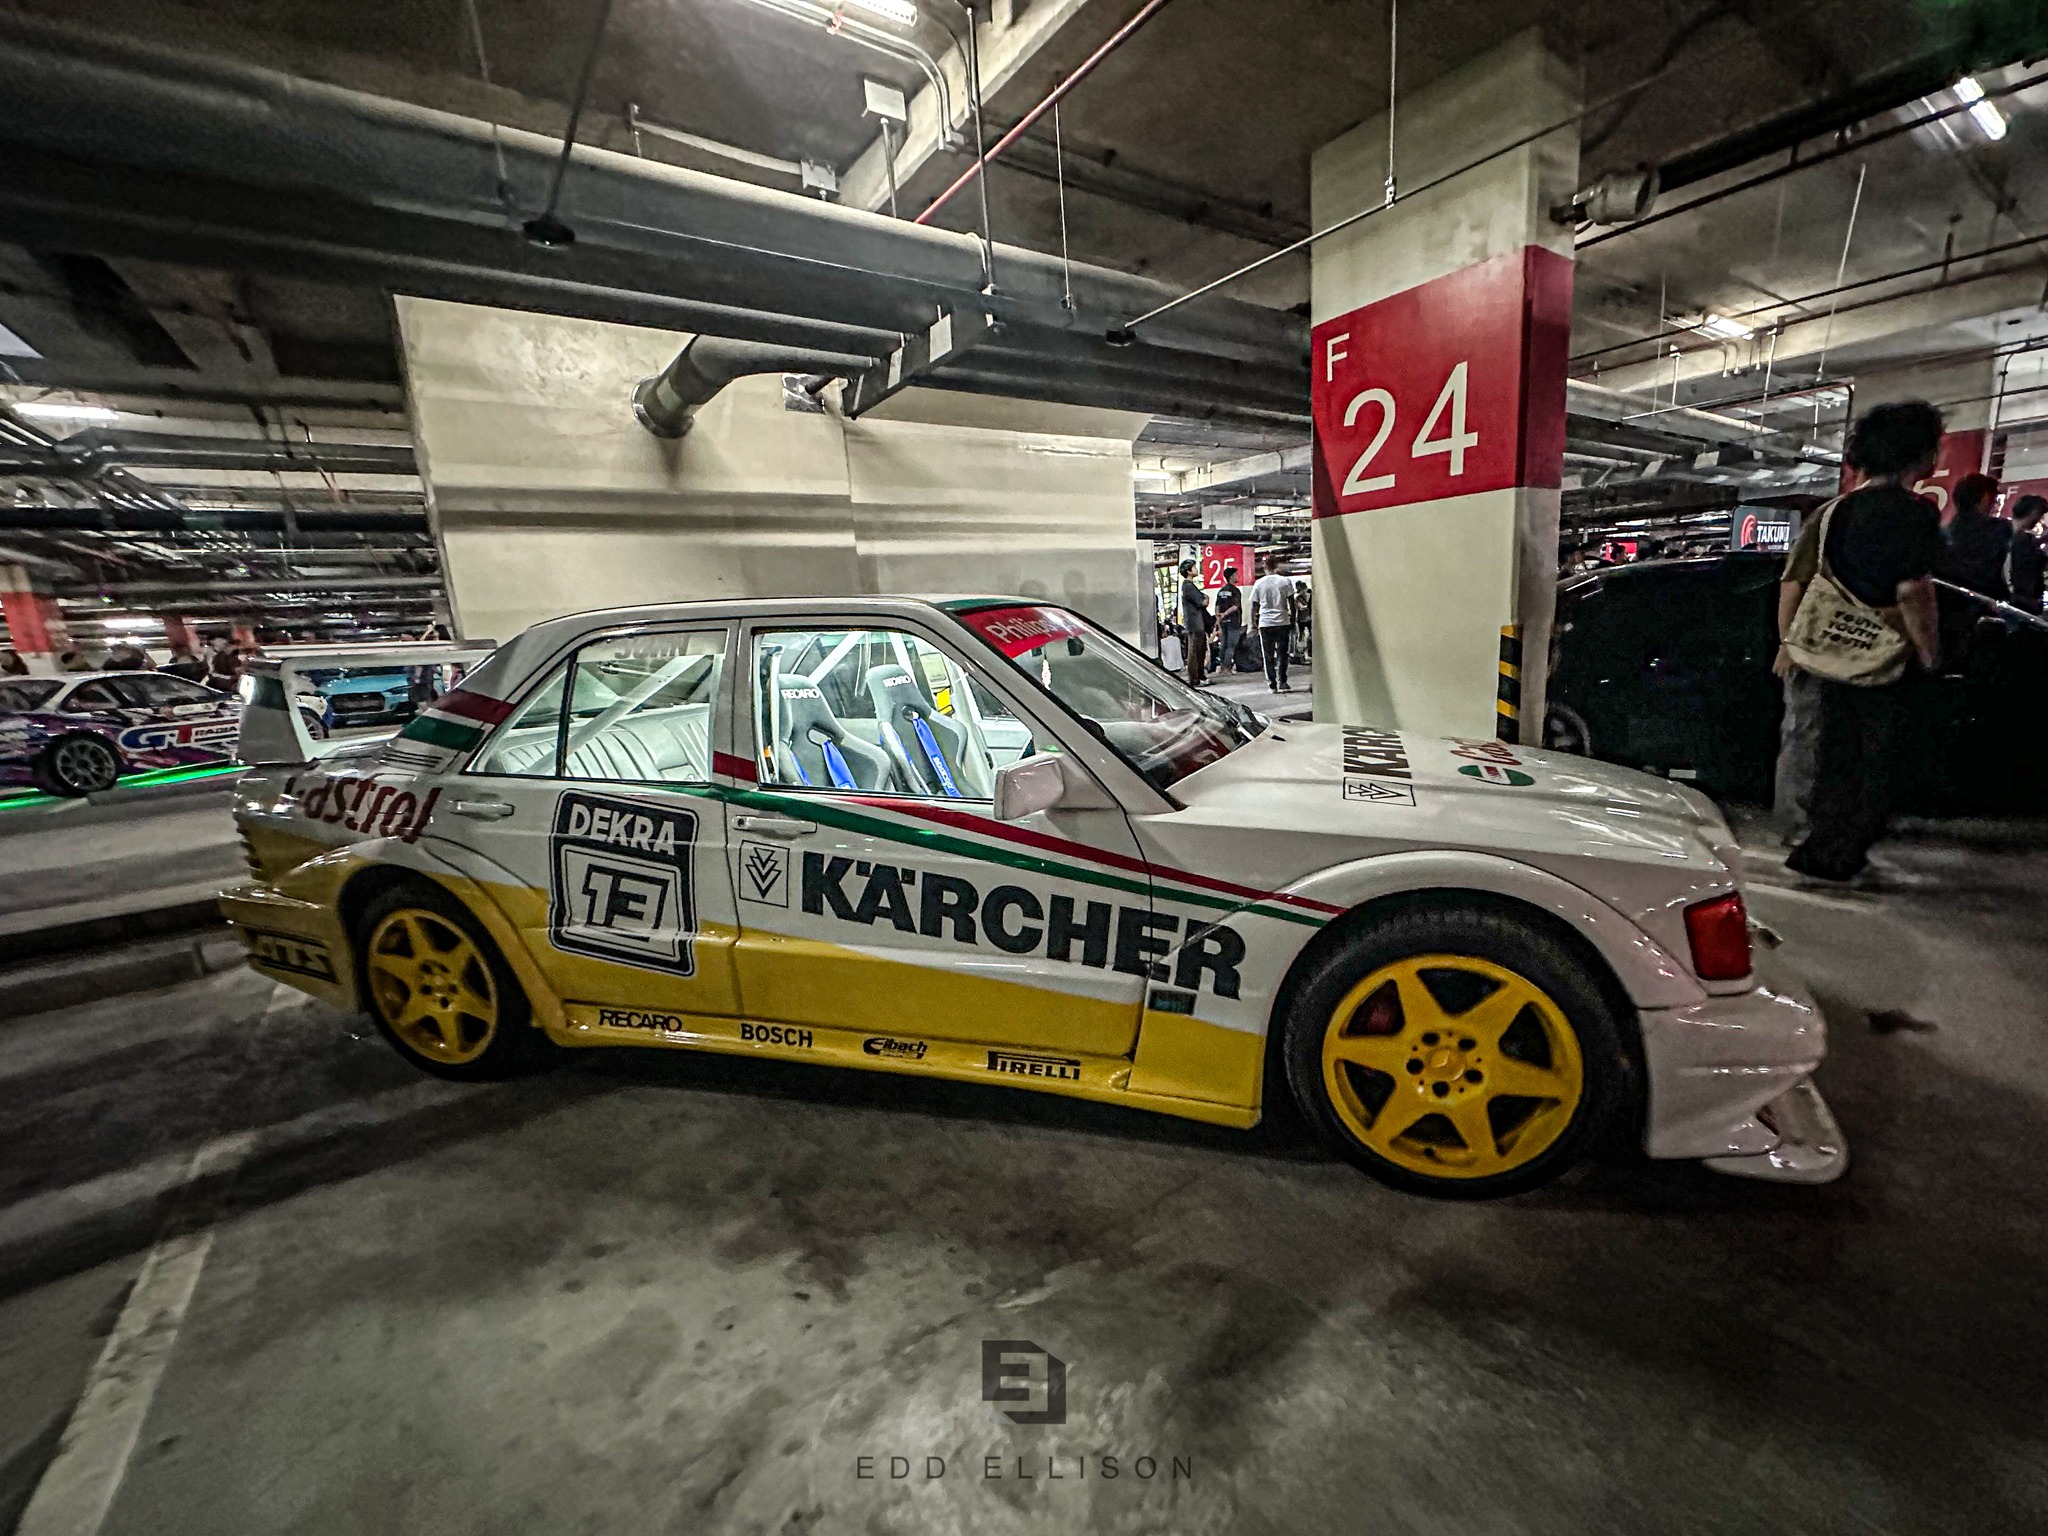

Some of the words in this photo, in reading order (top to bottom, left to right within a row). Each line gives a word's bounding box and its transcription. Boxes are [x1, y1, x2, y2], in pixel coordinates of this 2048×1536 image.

[1327, 332, 1350, 382] F
[1341, 360, 1479, 497] 24
[1205, 545, 1213, 557] G
[780, 687, 821, 699] RECARO
[567, 802, 676, 857] DEKRA
[801, 850, 1248, 1000] KÄRCHER
[599, 1008, 683, 1032] RECARO
[740, 1022, 813, 1048] BOSCH
[862, 1037, 929, 1057] Eibach
[987, 1050, 1081, 1081] PIRELLI
